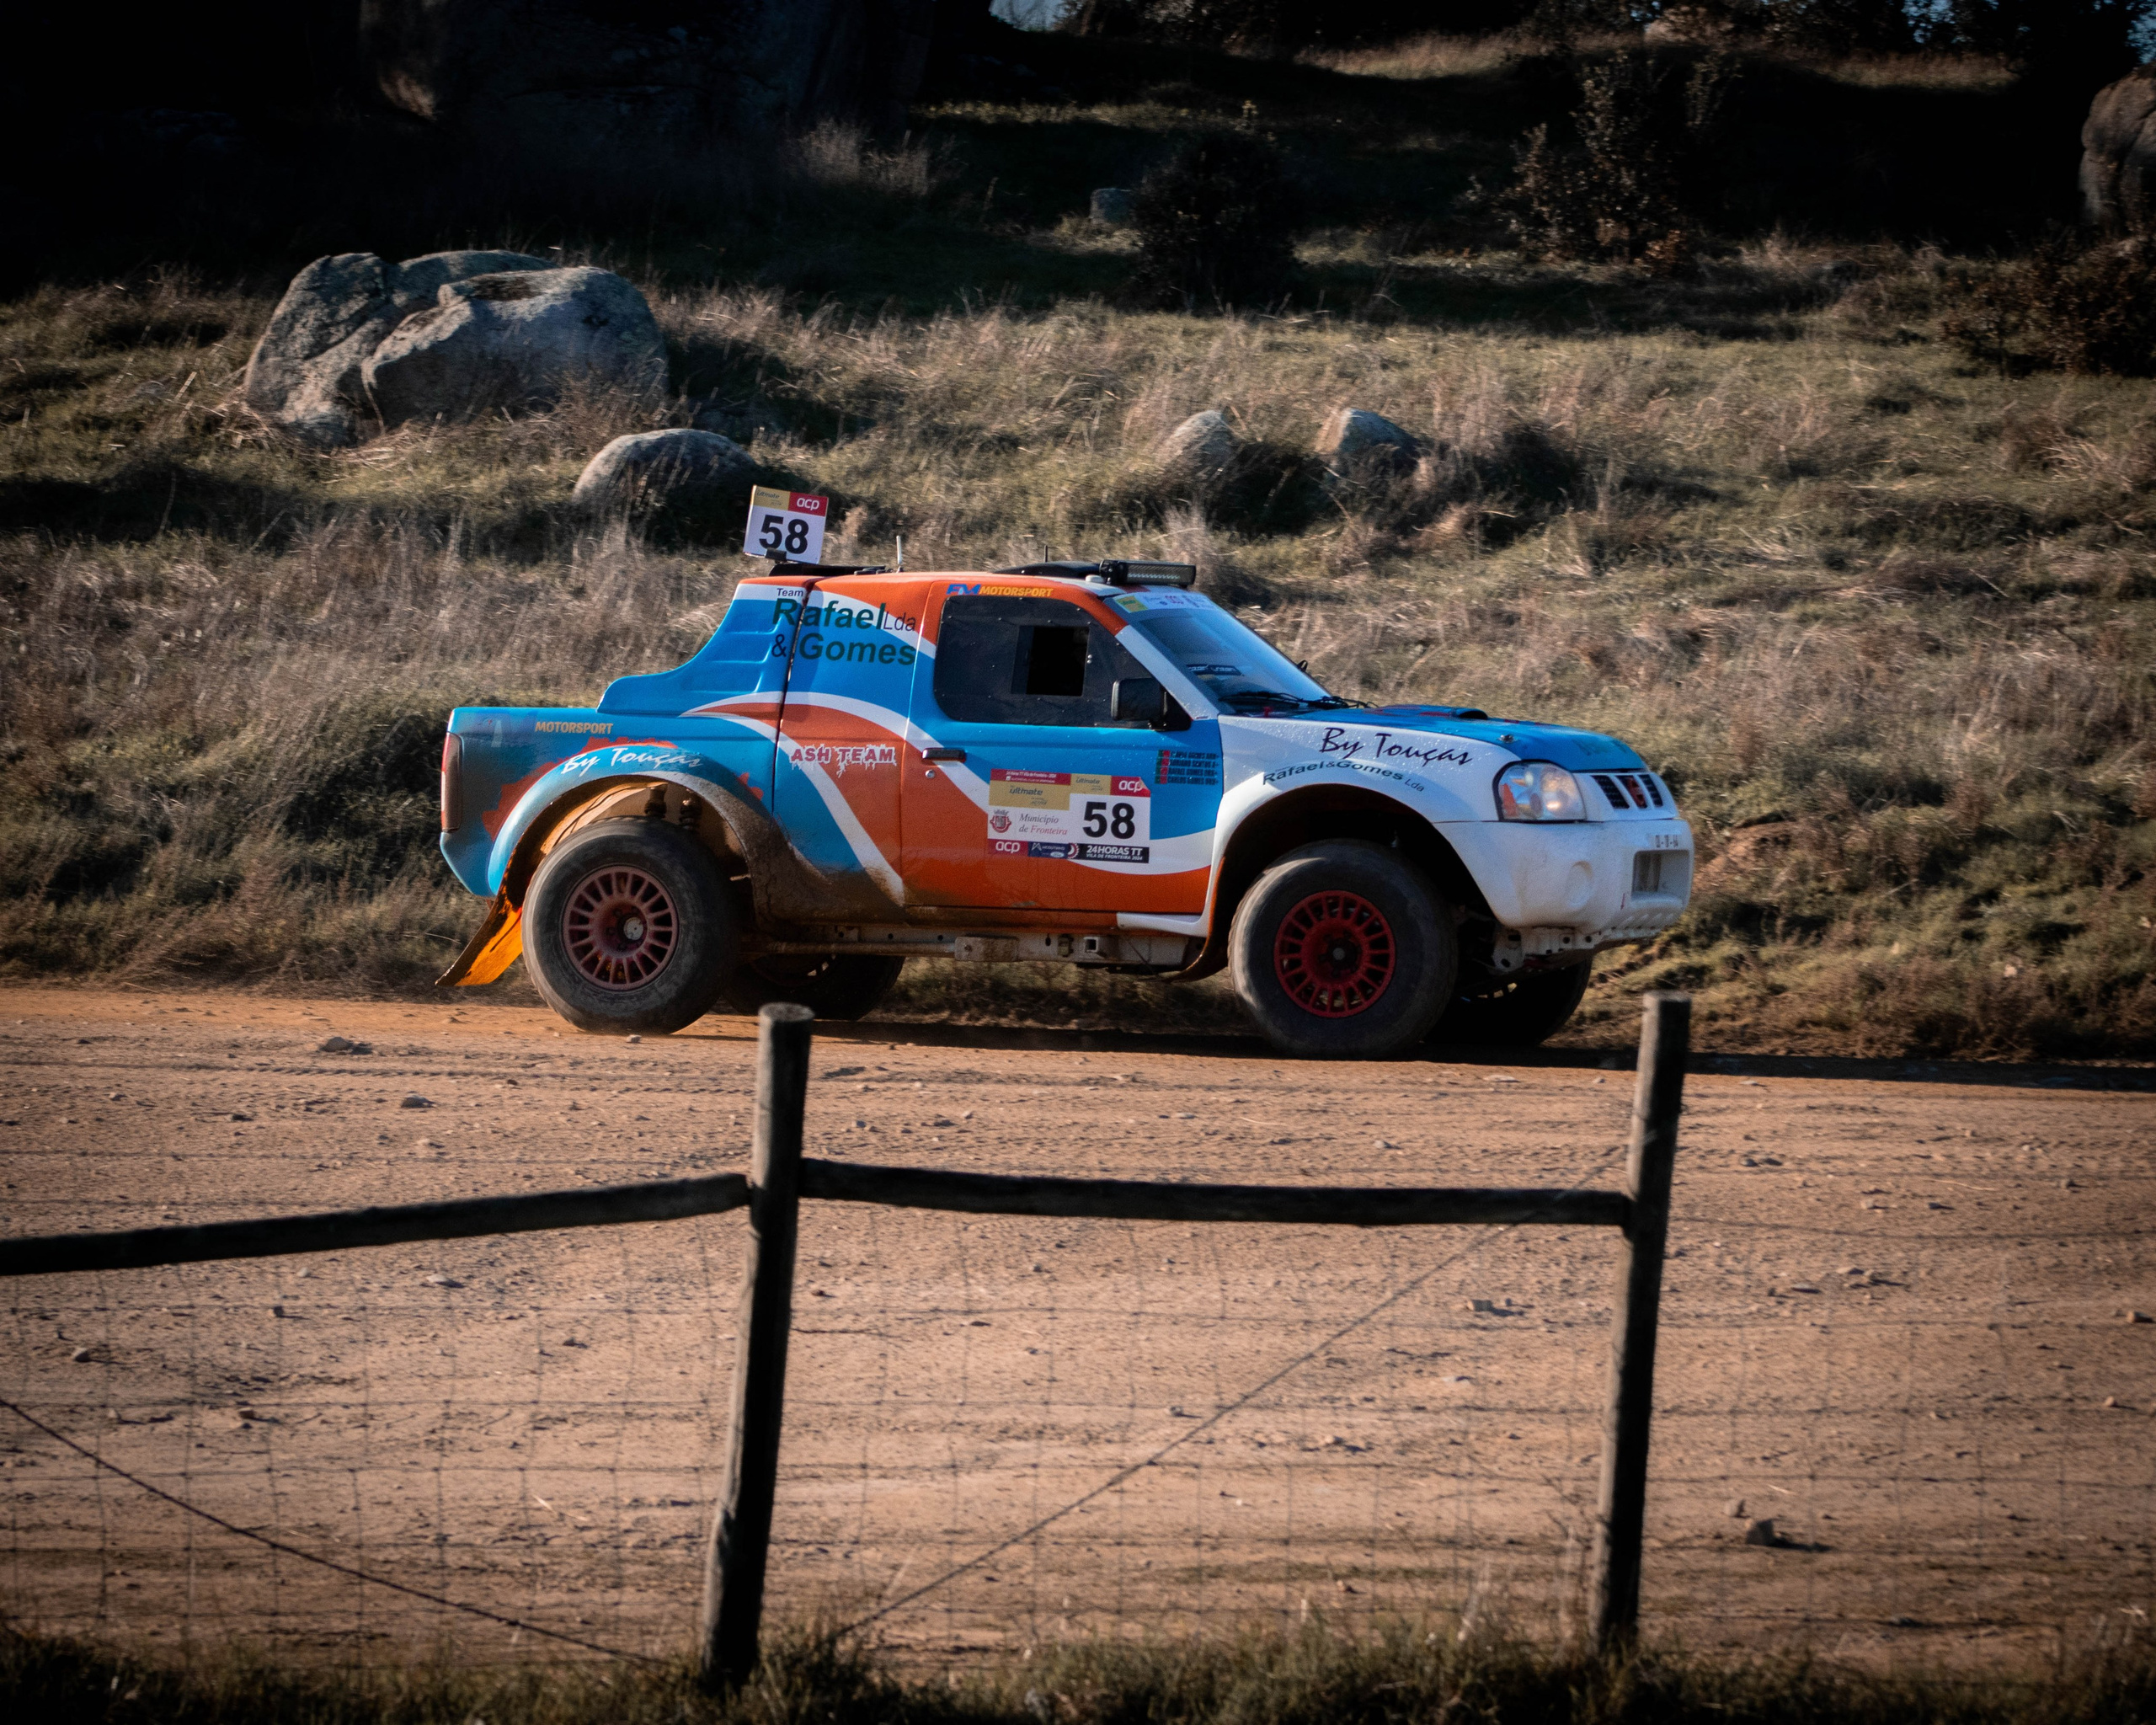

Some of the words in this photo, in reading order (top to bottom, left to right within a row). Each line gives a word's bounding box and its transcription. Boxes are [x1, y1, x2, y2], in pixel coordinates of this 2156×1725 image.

[797, 497, 820, 511] acp
[759, 514, 809, 554] 58
[776, 588, 803, 597] Team
[979, 585, 1054, 597] MOTORSPORT
[772, 598, 886, 630] Rafael
[883, 611, 916, 632] Lda
[771, 633, 787, 658] &
[799, 633, 917, 665] Gomes
[535, 721, 614, 734] MOTORSPORT
[790, 746, 831, 762] ASH
[837, 746, 895, 763] TEAM
[1319, 727, 1361, 760] By
[1374, 732, 1474, 767] Touças
[561, 753, 601, 777] By
[611, 747, 704, 769] Touças
[1405, 774, 1425, 793] Lda
[1019, 813, 1059, 825] Município
[1082, 801, 1135, 840] 58
[1018, 825, 1029, 833] de
[1030, 825, 1068, 836] Fronteira
[995, 841, 1021, 854] acp
[1131, 847, 1144, 856] TT
